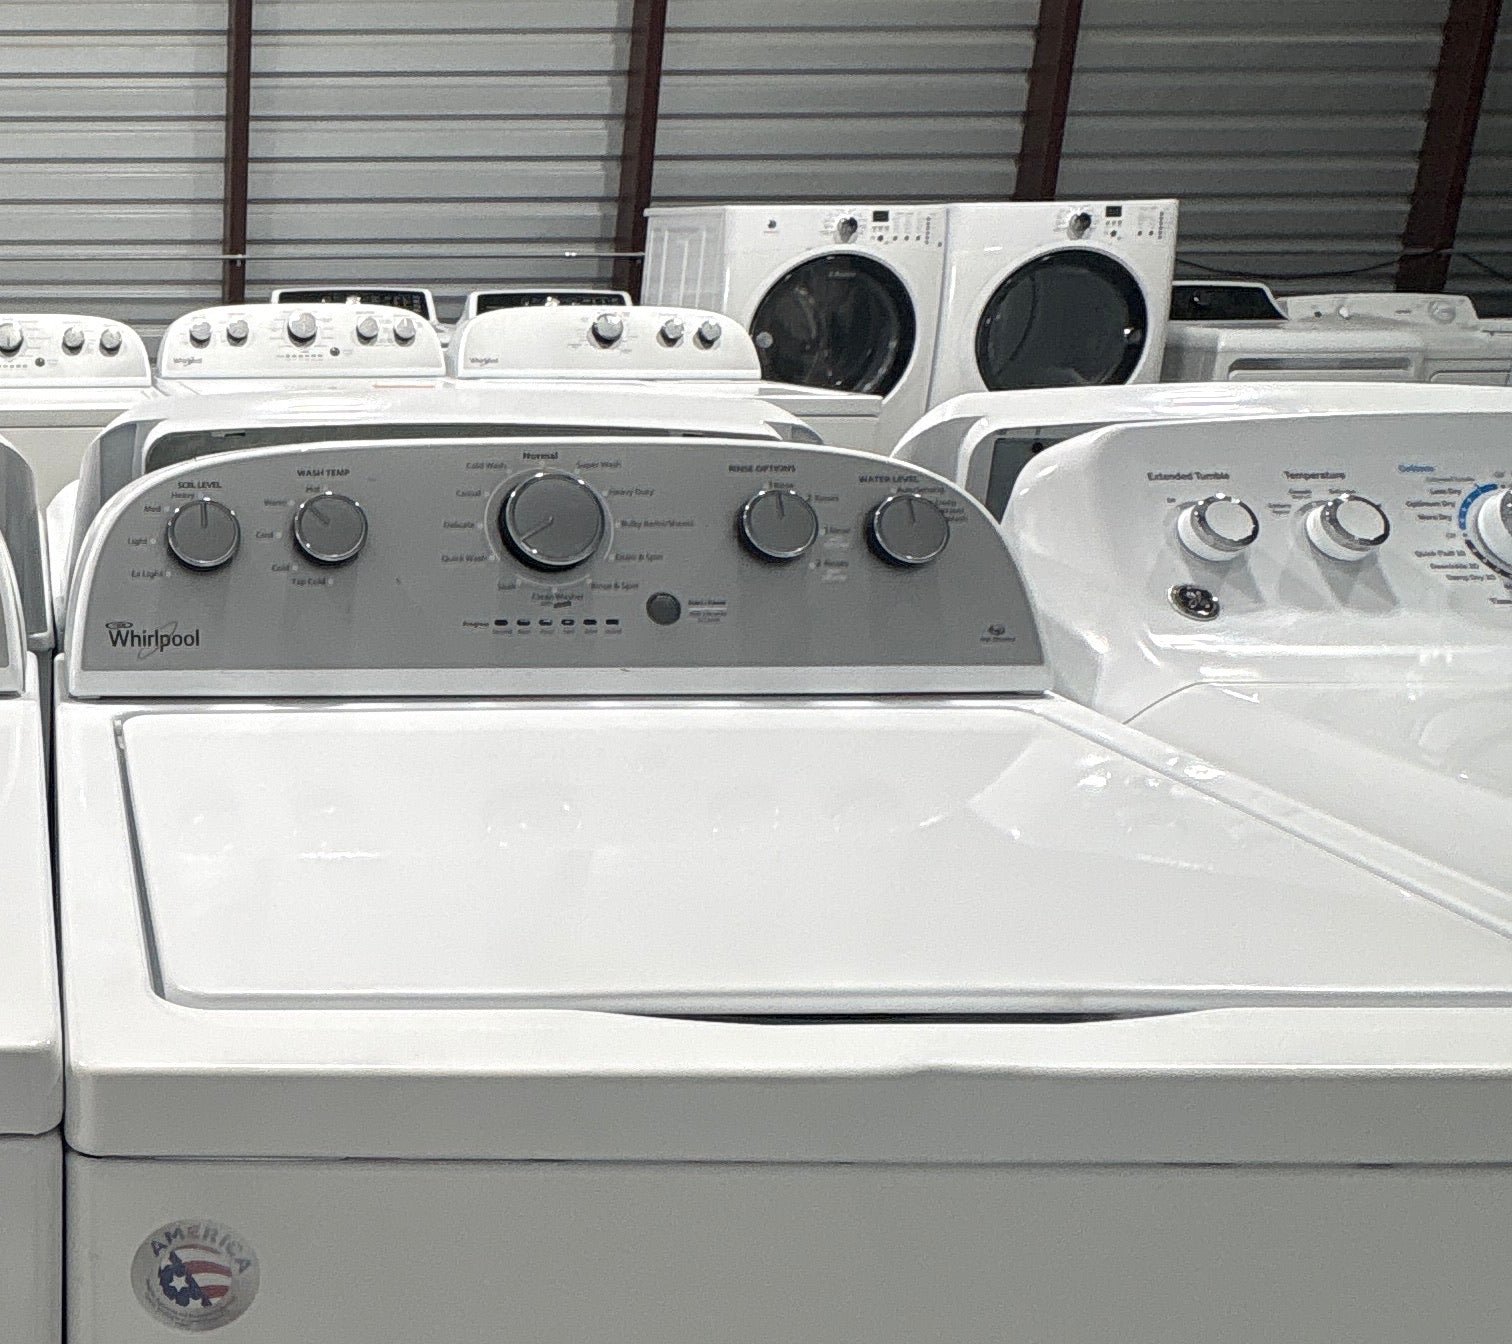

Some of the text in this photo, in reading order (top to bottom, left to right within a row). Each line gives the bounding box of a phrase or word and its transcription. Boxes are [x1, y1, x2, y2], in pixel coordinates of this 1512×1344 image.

[522, 451, 559, 460] Normal
[297, 468, 350, 477] WASH TEMP
[1147, 471, 1230, 481] Extended Tumble
[1284, 470, 1346, 481] Temperature
[859, 475, 919, 484] WATER LEVEL
[197, 481, 222, 489] LEVEL
[108, 628, 200, 653] Whirlpool
[150, 1223, 252, 1275] AMERICA
